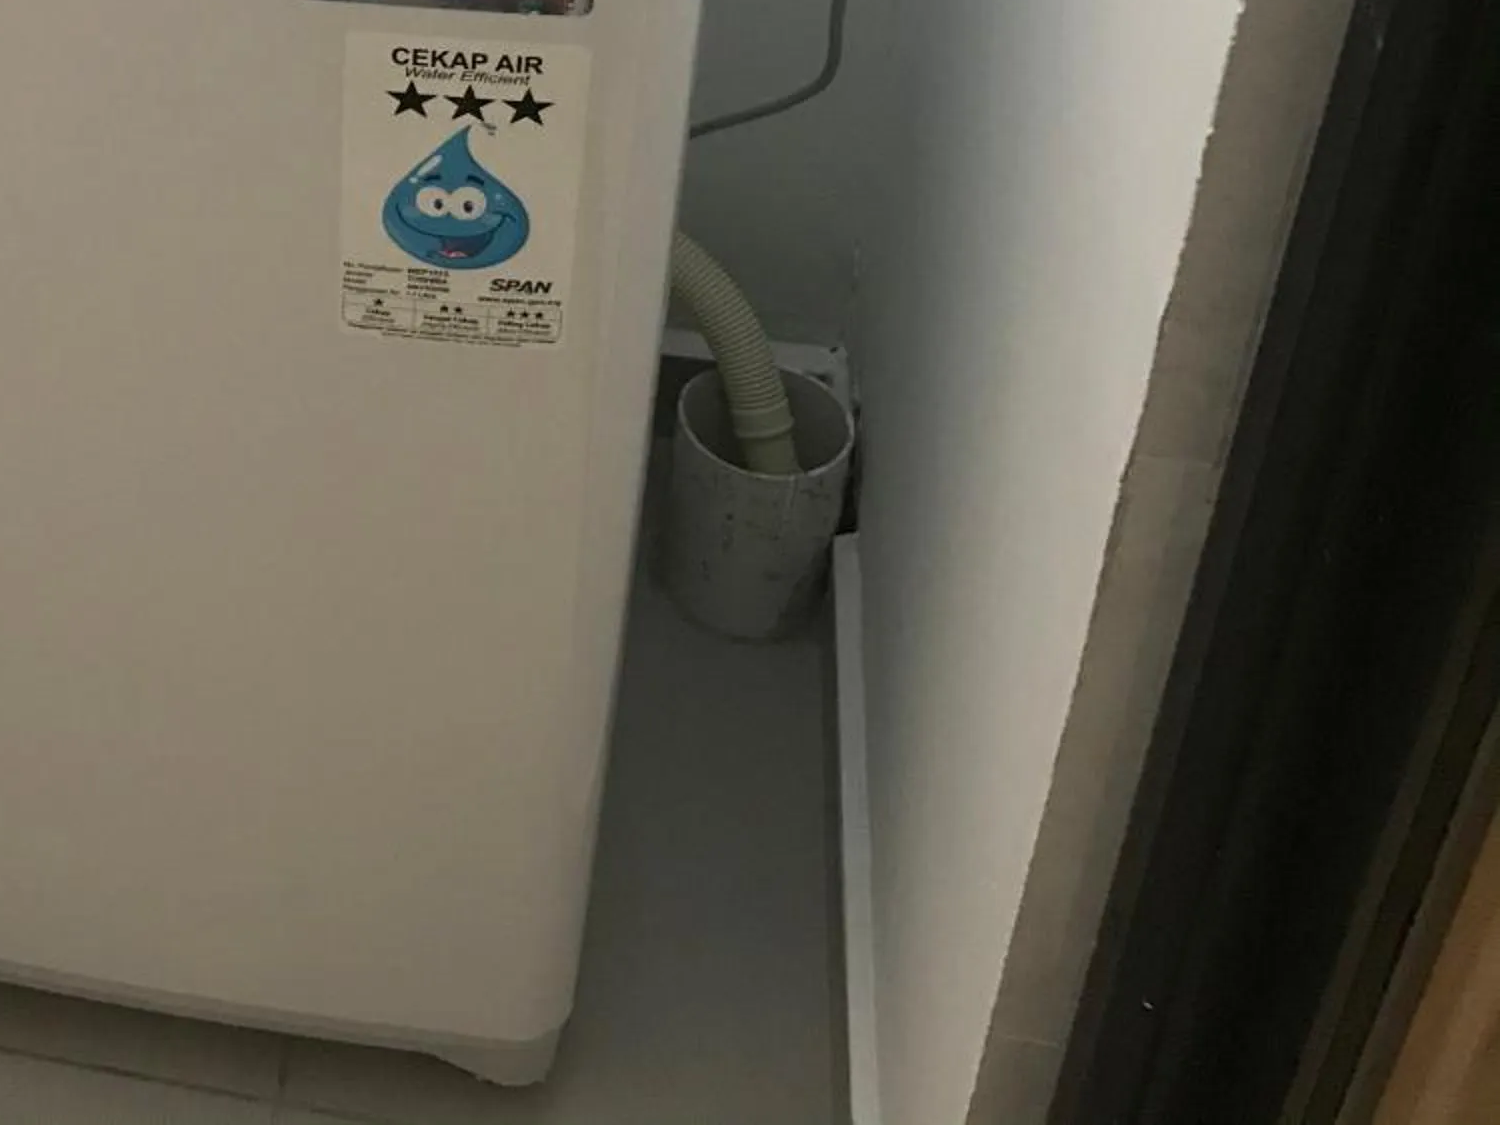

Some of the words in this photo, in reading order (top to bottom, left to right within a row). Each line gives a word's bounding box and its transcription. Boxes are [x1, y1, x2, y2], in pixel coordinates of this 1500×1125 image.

[391, 46, 489, 71] CEKAP
[495, 54, 544, 75] AIR
[405, 66, 455, 82] Water
[460, 71, 531, 87] Efficient
[489, 277, 554, 294] SPAN
